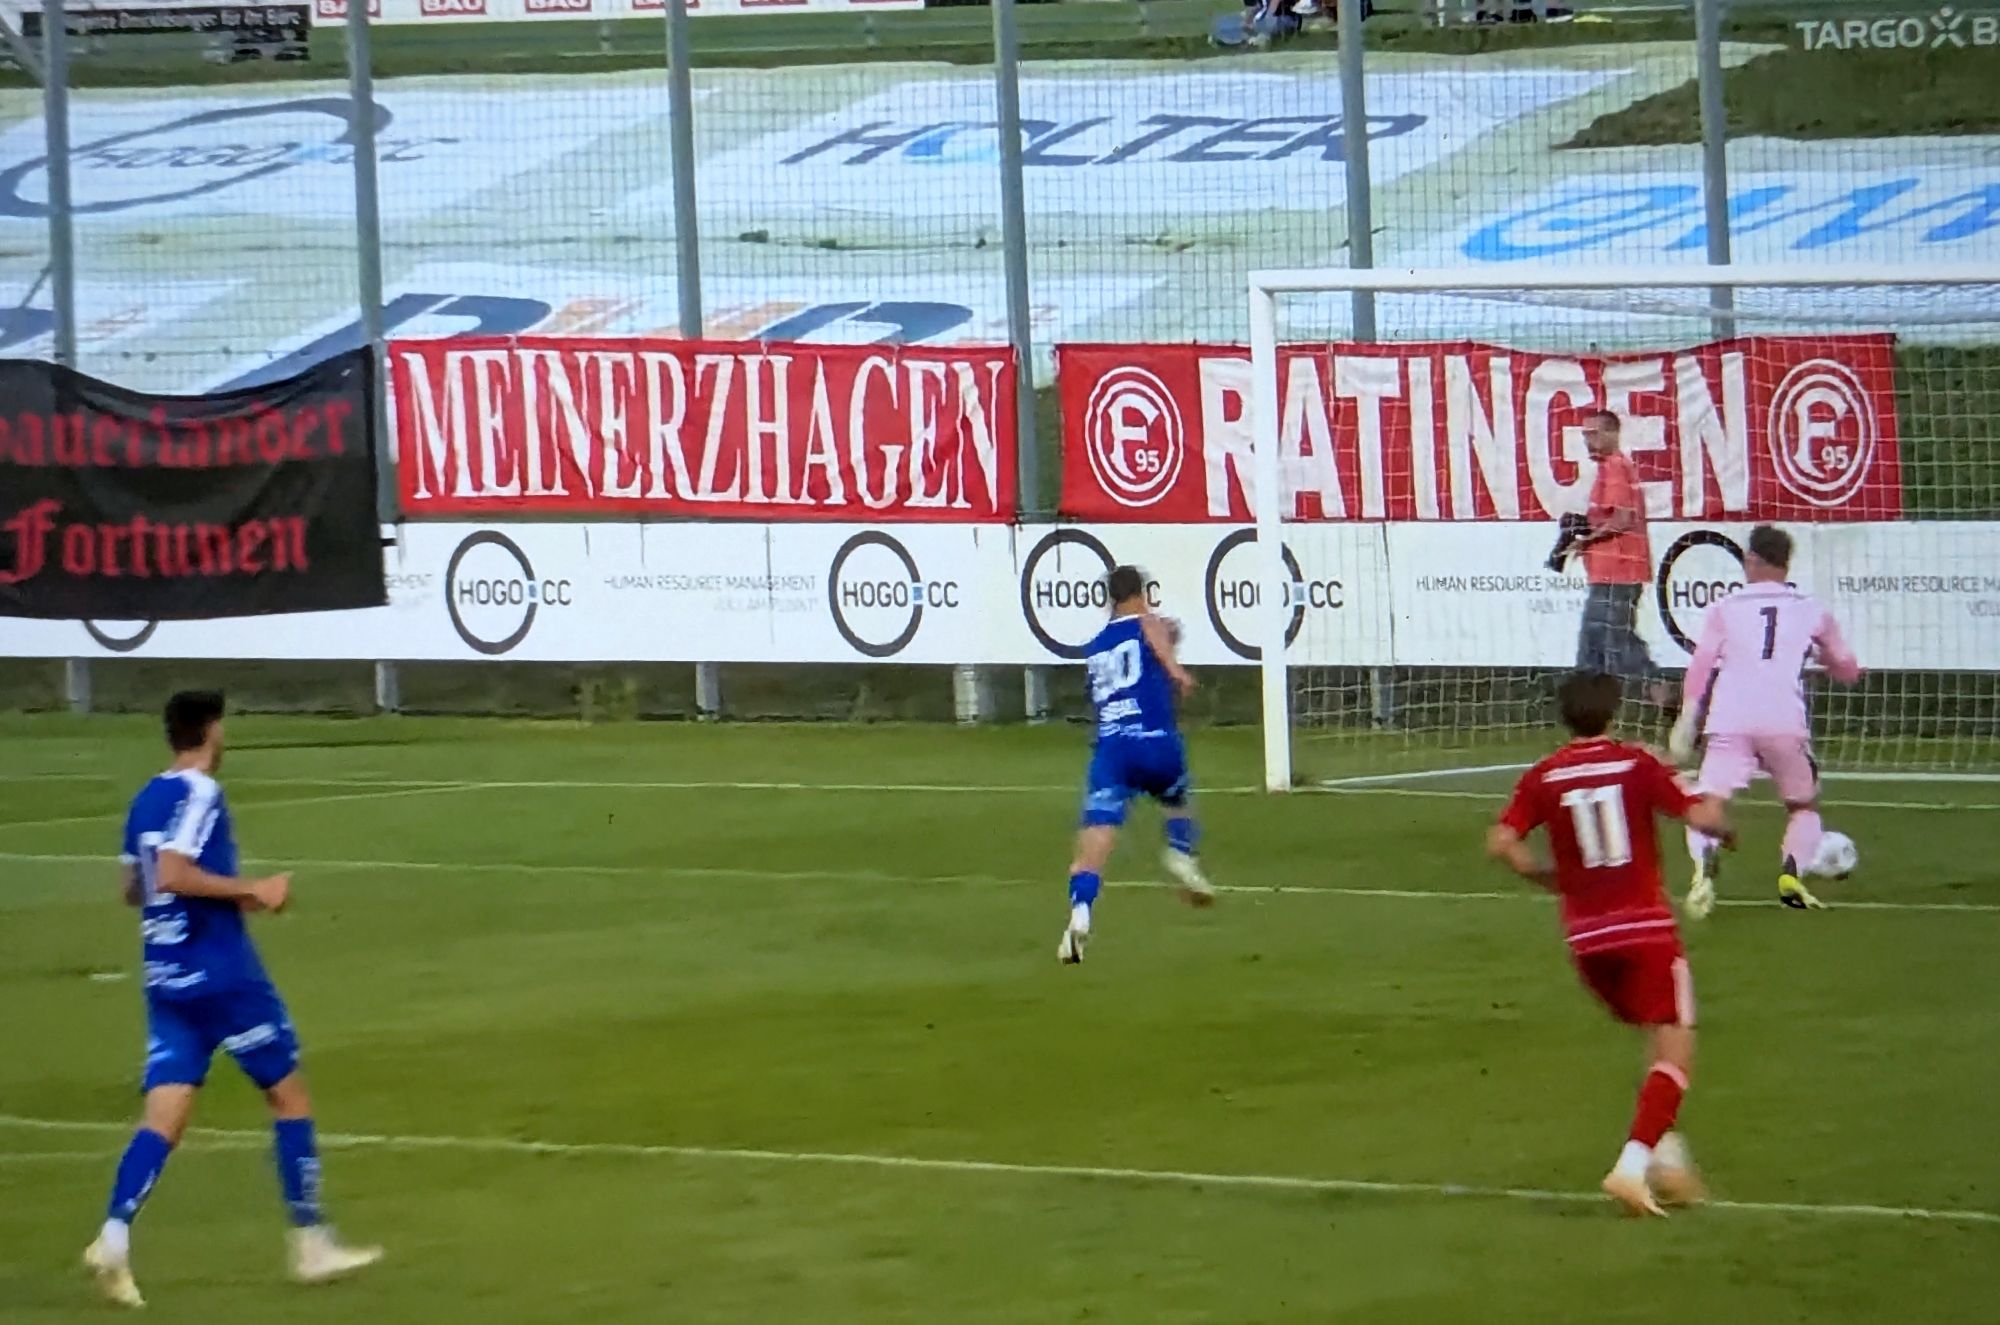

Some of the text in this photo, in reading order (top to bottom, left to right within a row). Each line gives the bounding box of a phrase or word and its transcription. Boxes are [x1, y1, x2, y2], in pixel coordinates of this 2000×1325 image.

[779, 113, 1427, 166] HOLTER
[401, 349, 1004, 514] MEINERZHAGEN
[1200, 351, 1750, 520] RATINGEN
[1134, 448, 1160, 473] 95
[1821, 445, 1849, 469] 95
[459, 580, 572, 605] HOGO CC
[604, 575, 653, 589] HUMAN
[657, 575, 721, 590] RESOURCE
[842, 581, 908, 607] HOGO
[928, 581, 959, 608] CC
[1036, 580, 1108, 608] HOGO
[1220, 581, 1290, 607] HO
[1417, 576, 1467, 591] HUMAN
[1471, 576, 1542, 591] RESOURCE
[1838, 576, 1898, 592] HUMAN
[1902, 576, 1980, 592] RESOURCE
[1759, 606, 1778, 659] 1
[1560, 784, 1632, 869] 11
